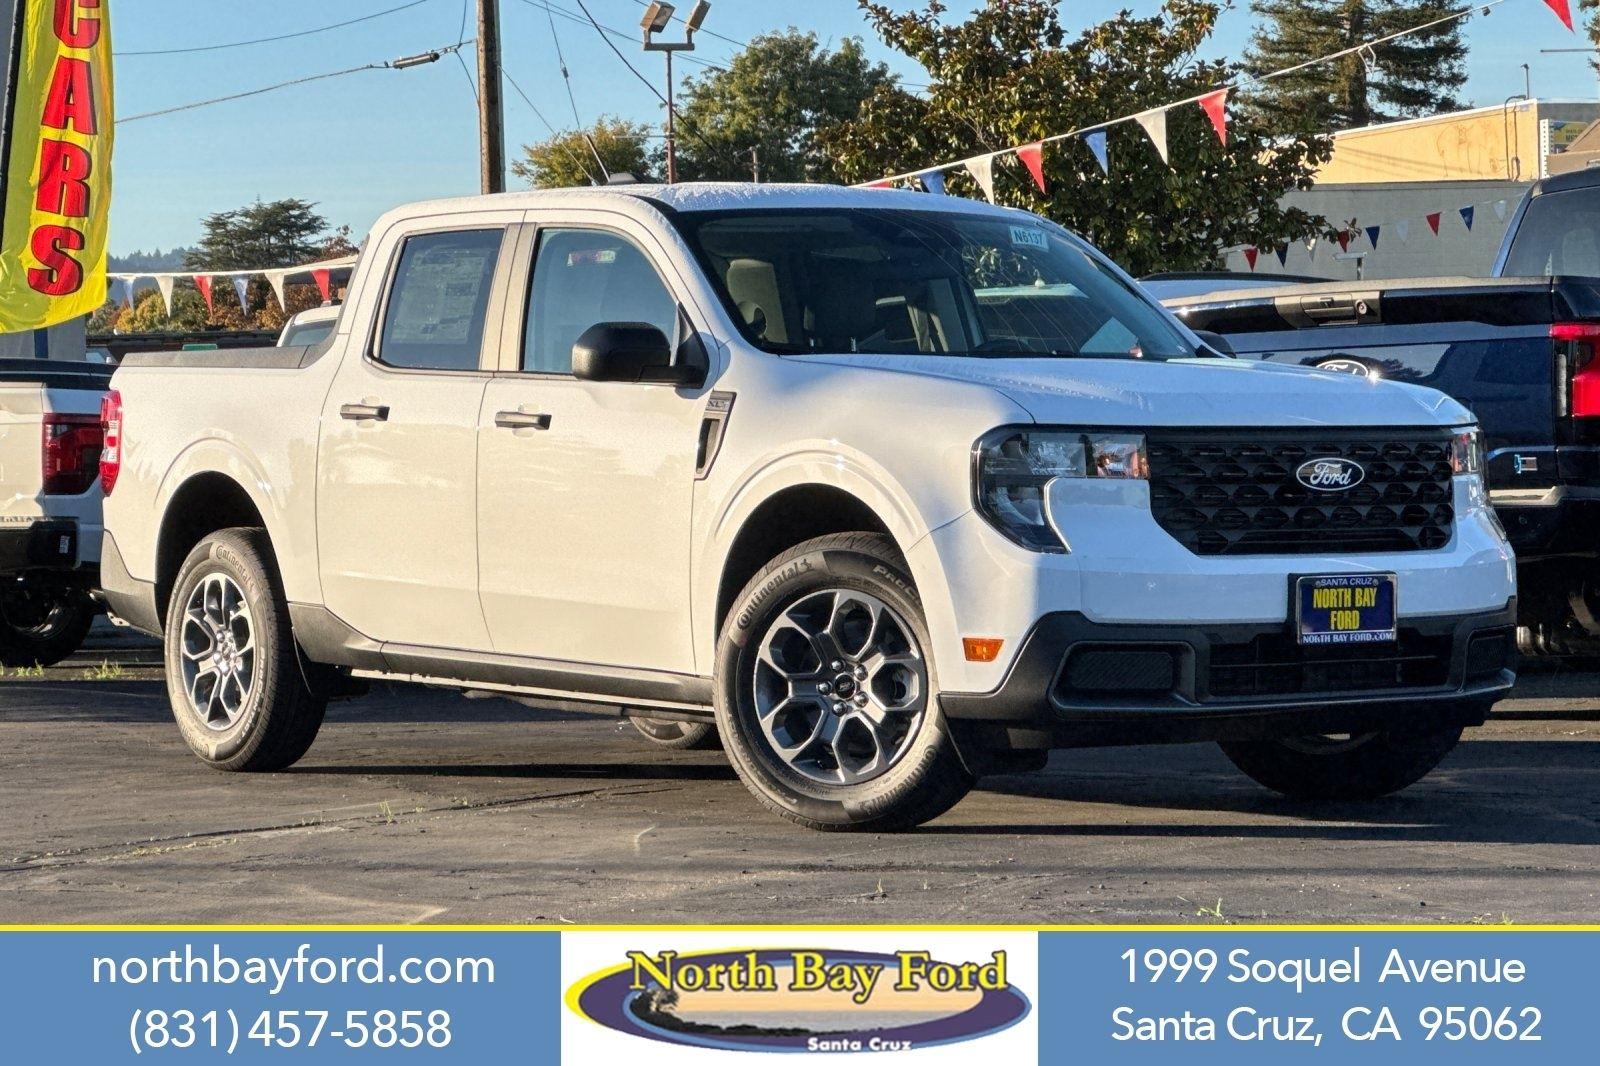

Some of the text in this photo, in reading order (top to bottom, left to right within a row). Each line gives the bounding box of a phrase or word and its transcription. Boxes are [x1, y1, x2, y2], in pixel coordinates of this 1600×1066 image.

[27, 0, 101, 296] CARS
[1013, 229, 1044, 246] N6137
[1310, 462, 1352, 485] Ford
[1350, 578, 1373, 586] CRUZ
[1313, 587, 1377, 608] NORTH BAY
[1330, 610, 1360, 630] FORD
[1302, 632, 1393, 644] NORTH BAY FORD.COM
